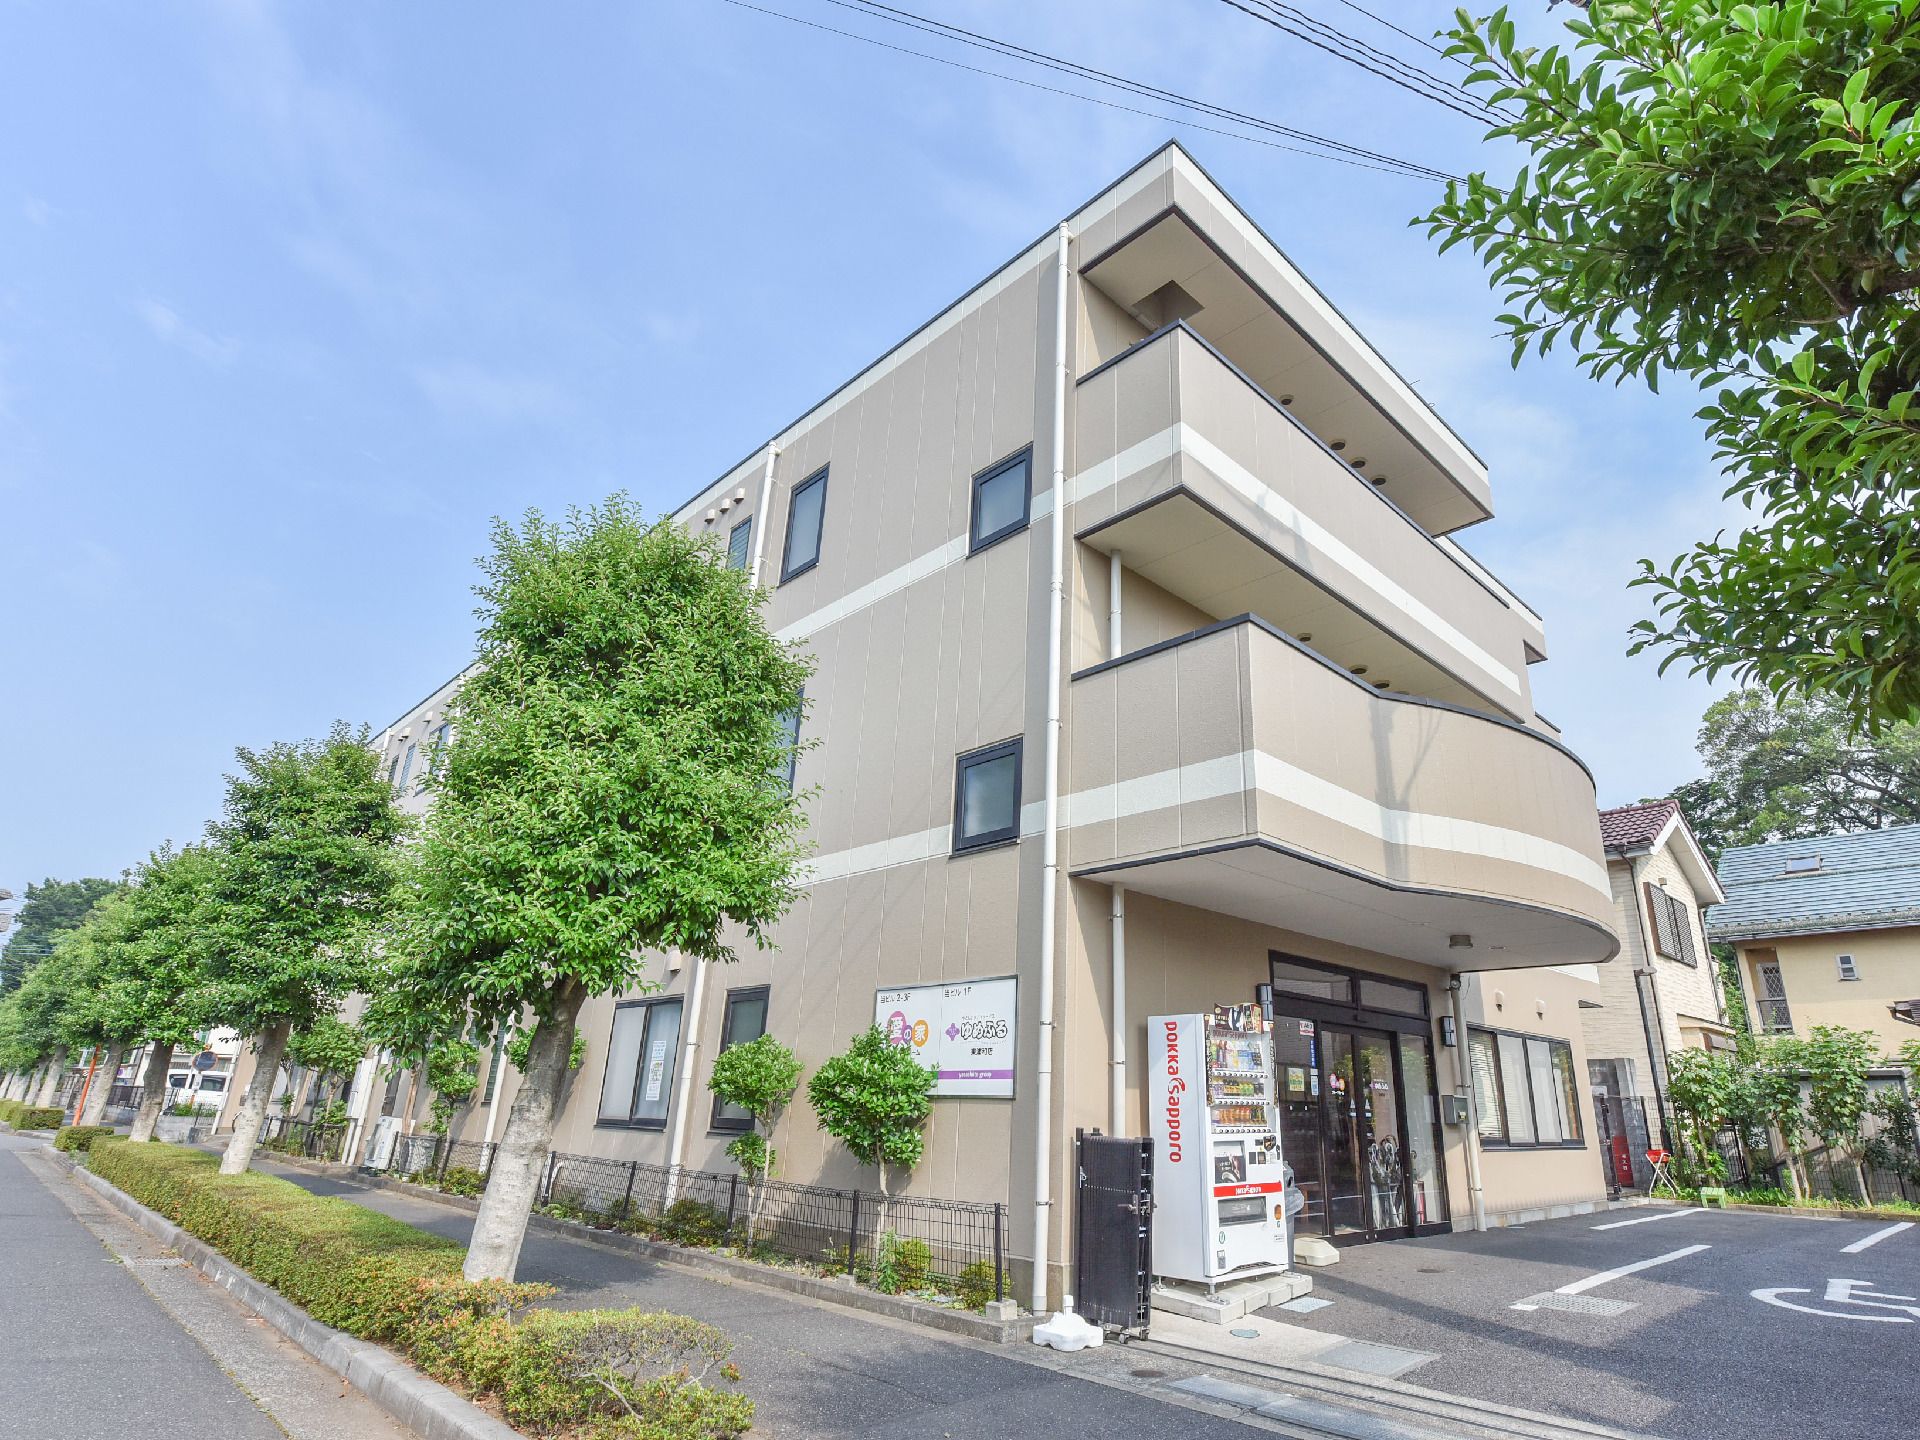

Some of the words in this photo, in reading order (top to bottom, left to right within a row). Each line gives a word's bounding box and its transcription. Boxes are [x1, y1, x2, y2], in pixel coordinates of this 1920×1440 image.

[964, 986, 972, 996] 1F
[896, 992, 911, 1002] 2-3F
[960, 1019, 1008, 1040] ゆめふる
